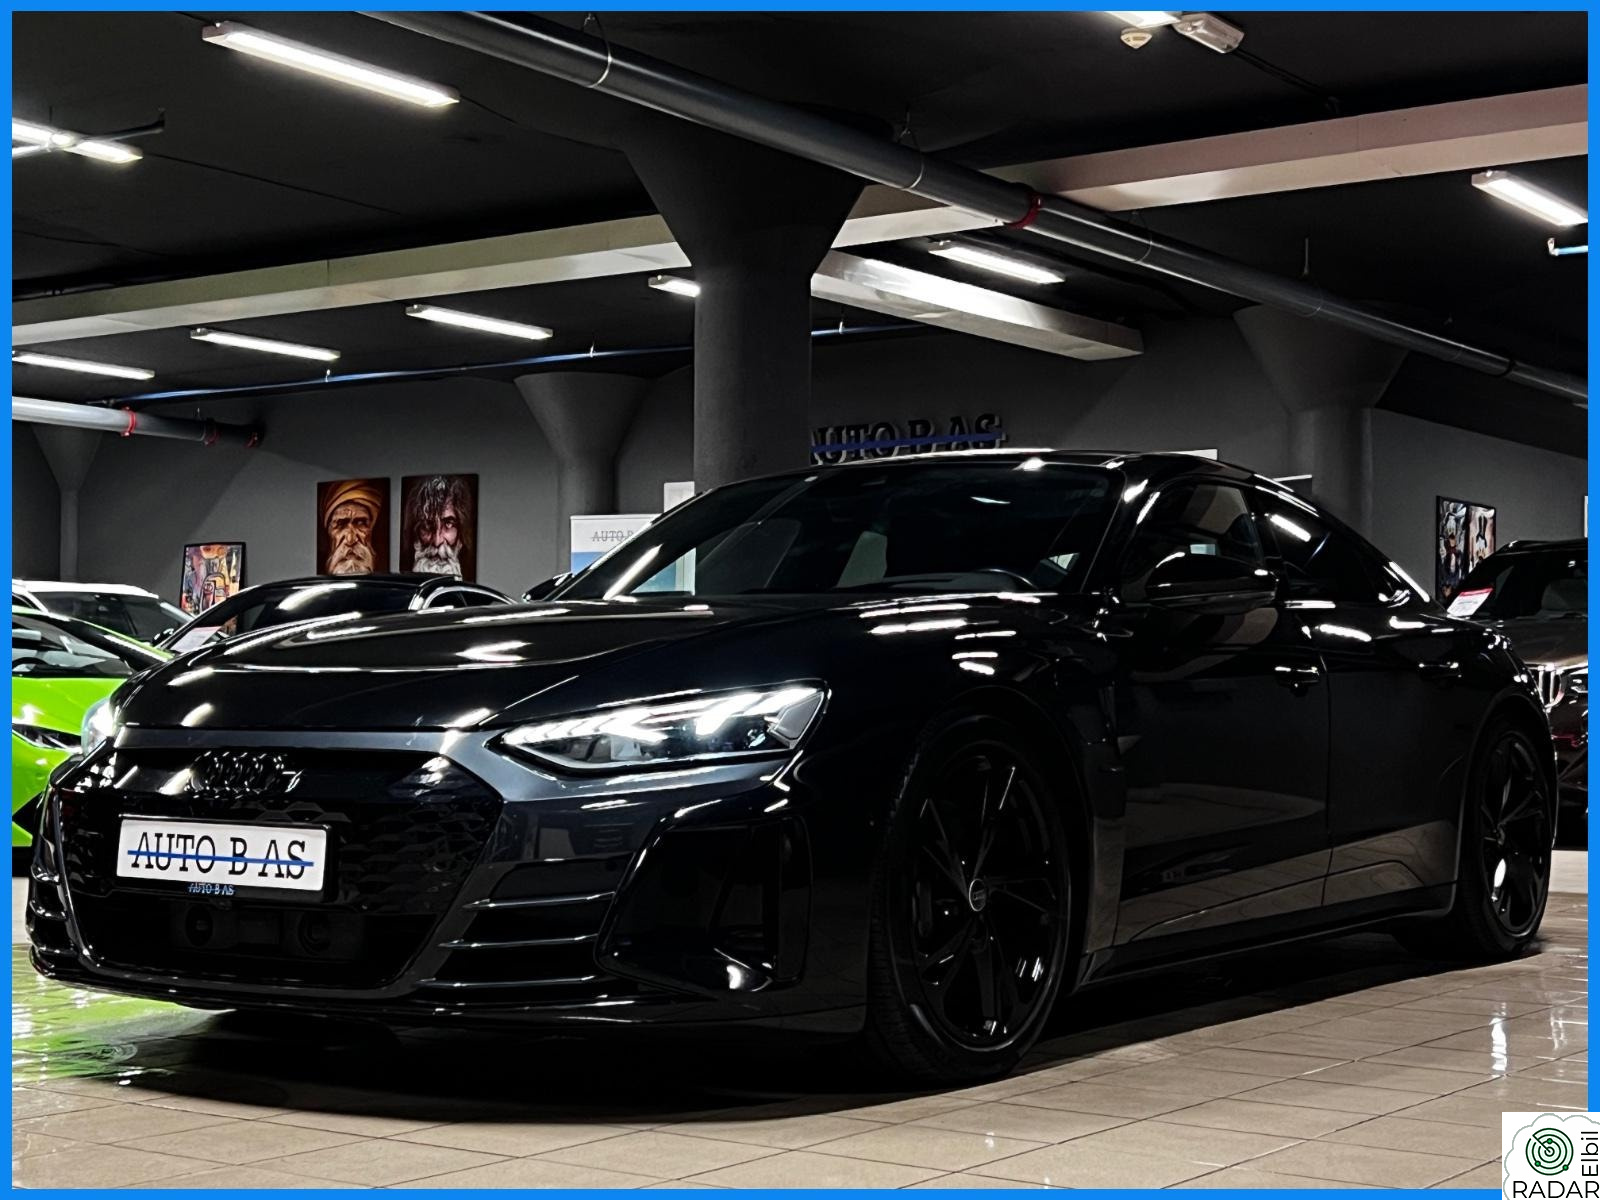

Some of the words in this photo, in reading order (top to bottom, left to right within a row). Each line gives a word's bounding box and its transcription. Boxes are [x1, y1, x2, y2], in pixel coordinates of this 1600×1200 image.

[592, 530, 624, 542] AUTO
[131, 832, 216, 873] AUTO
[229, 837, 248, 875] B
[258, 839, 306, 879] AS
[187, 882, 212, 894] AUTO
[222, 884, 235, 896] AS
